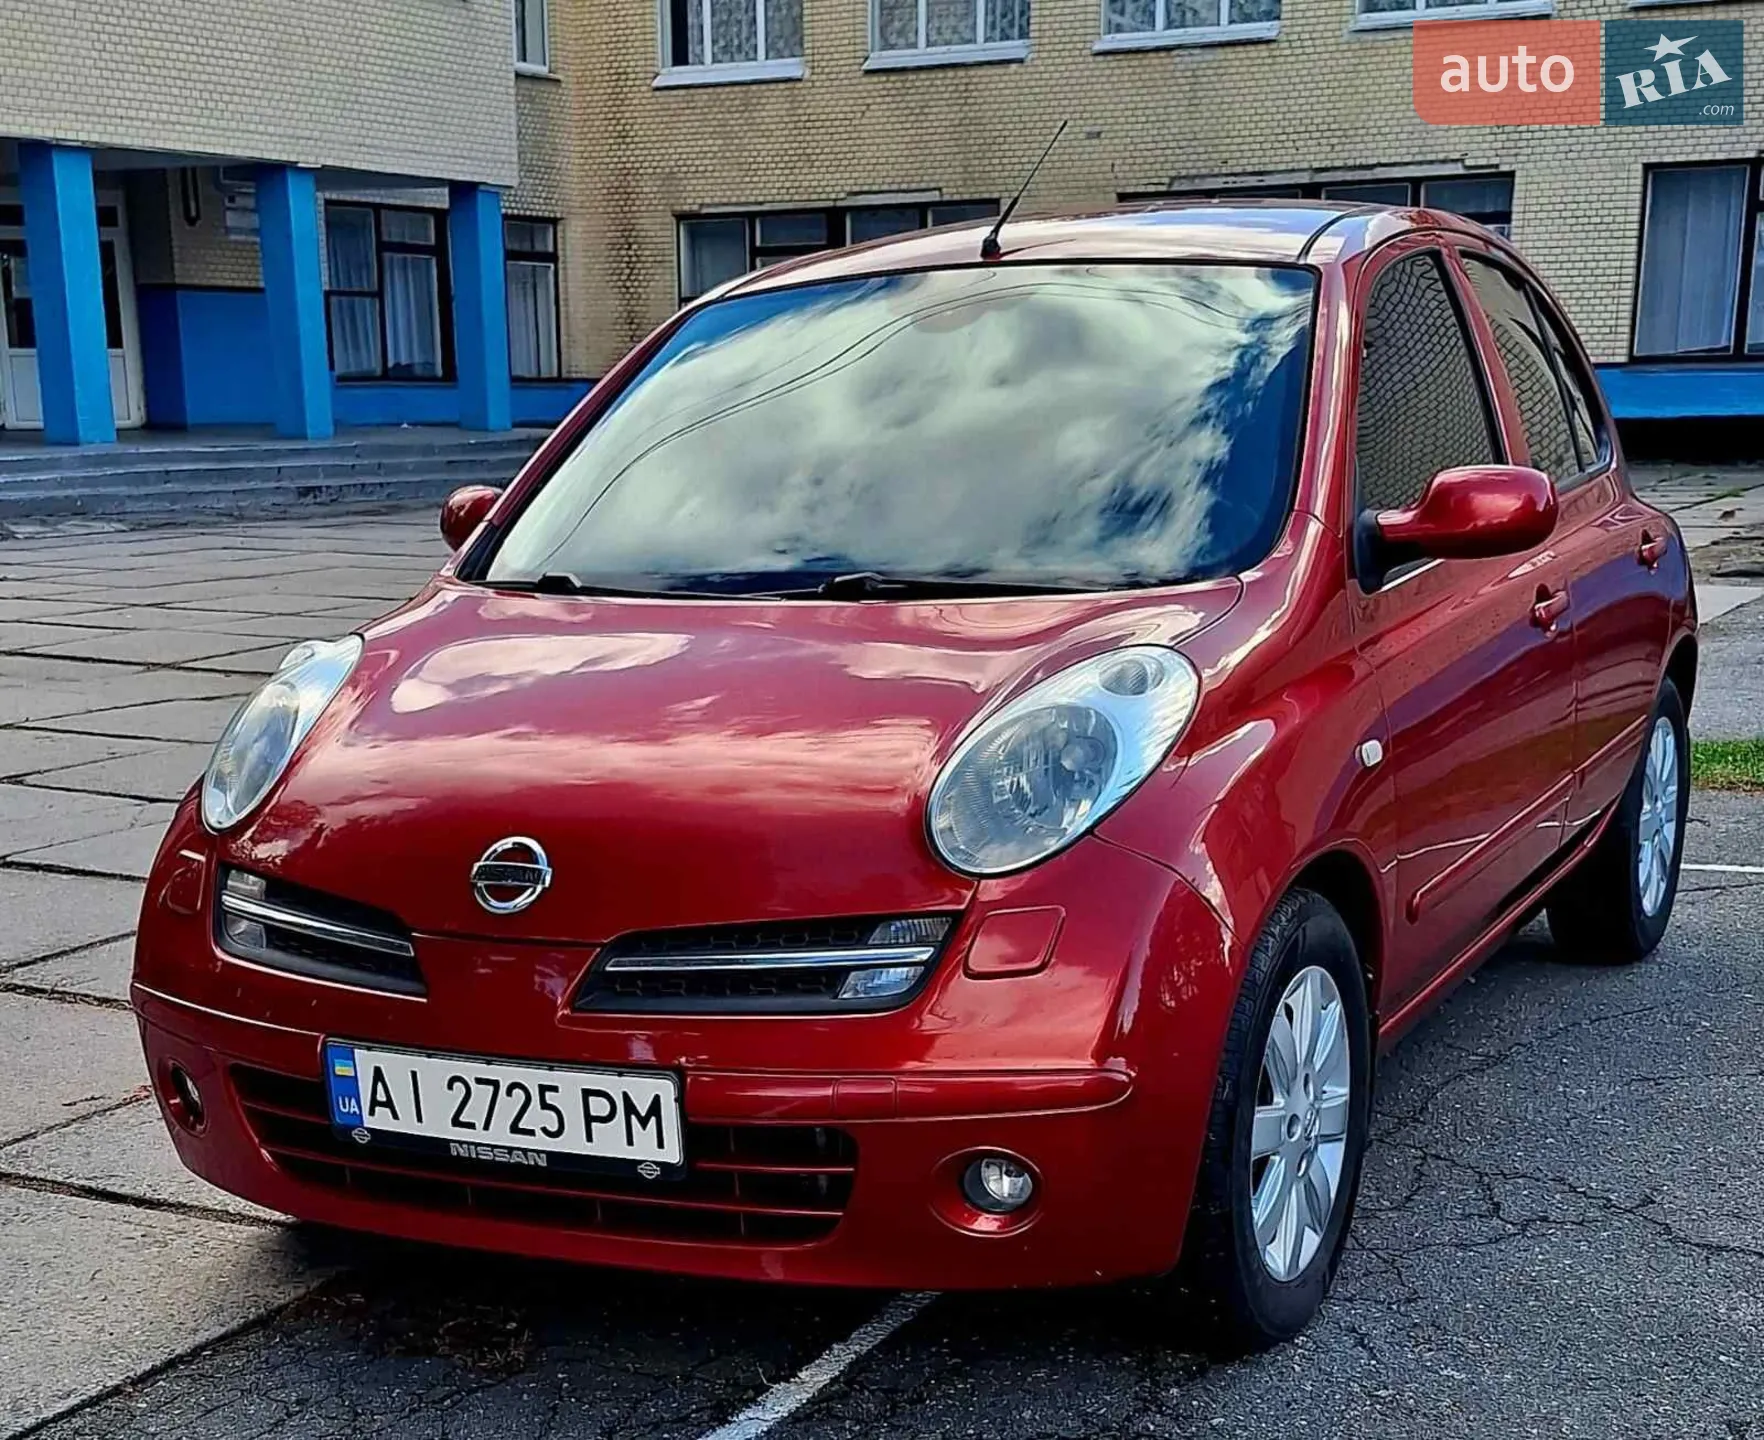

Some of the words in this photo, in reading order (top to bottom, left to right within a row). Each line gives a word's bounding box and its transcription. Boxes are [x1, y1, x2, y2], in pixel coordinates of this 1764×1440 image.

[339, 1097, 360, 1114] UA
[367, 1065, 424, 1124] AI
[446, 1075, 566, 1140] 2725
[580, 1087, 666, 1150] PM
[450, 1143, 547, 1167] NISSAN
